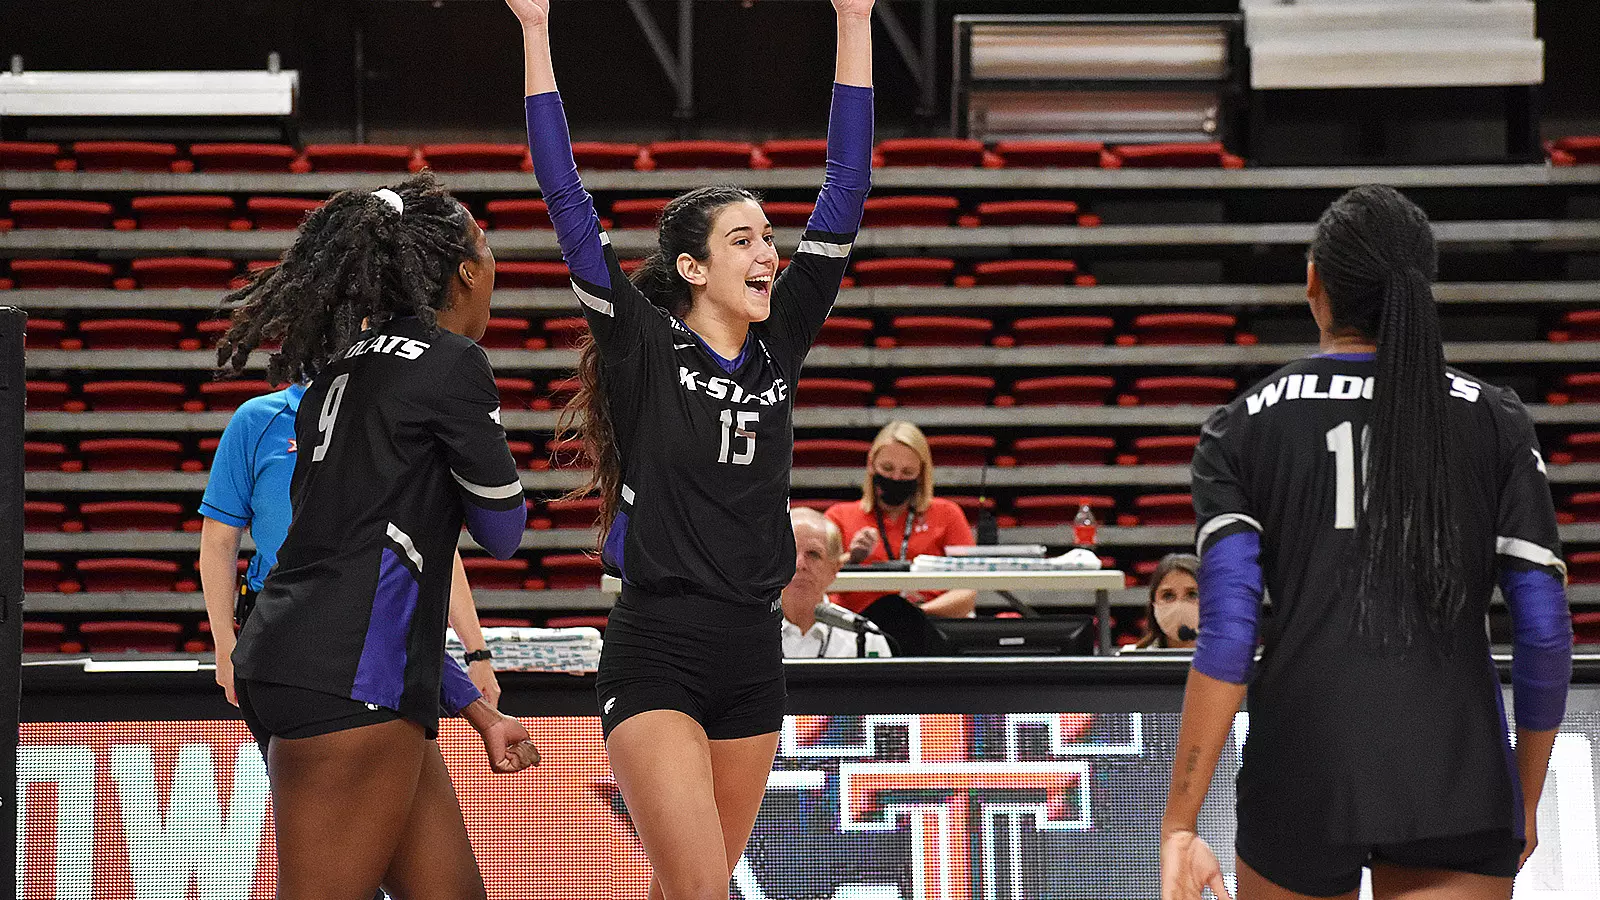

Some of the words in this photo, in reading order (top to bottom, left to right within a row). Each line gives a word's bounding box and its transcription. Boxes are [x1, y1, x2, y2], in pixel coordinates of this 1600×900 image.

[327, 334, 431, 365] DCATS
[679, 366, 788, 406] K-STATE
[1245, 373, 1482, 416] WILDS
[311, 372, 350, 462] 9
[717, 408, 760, 465] 15
